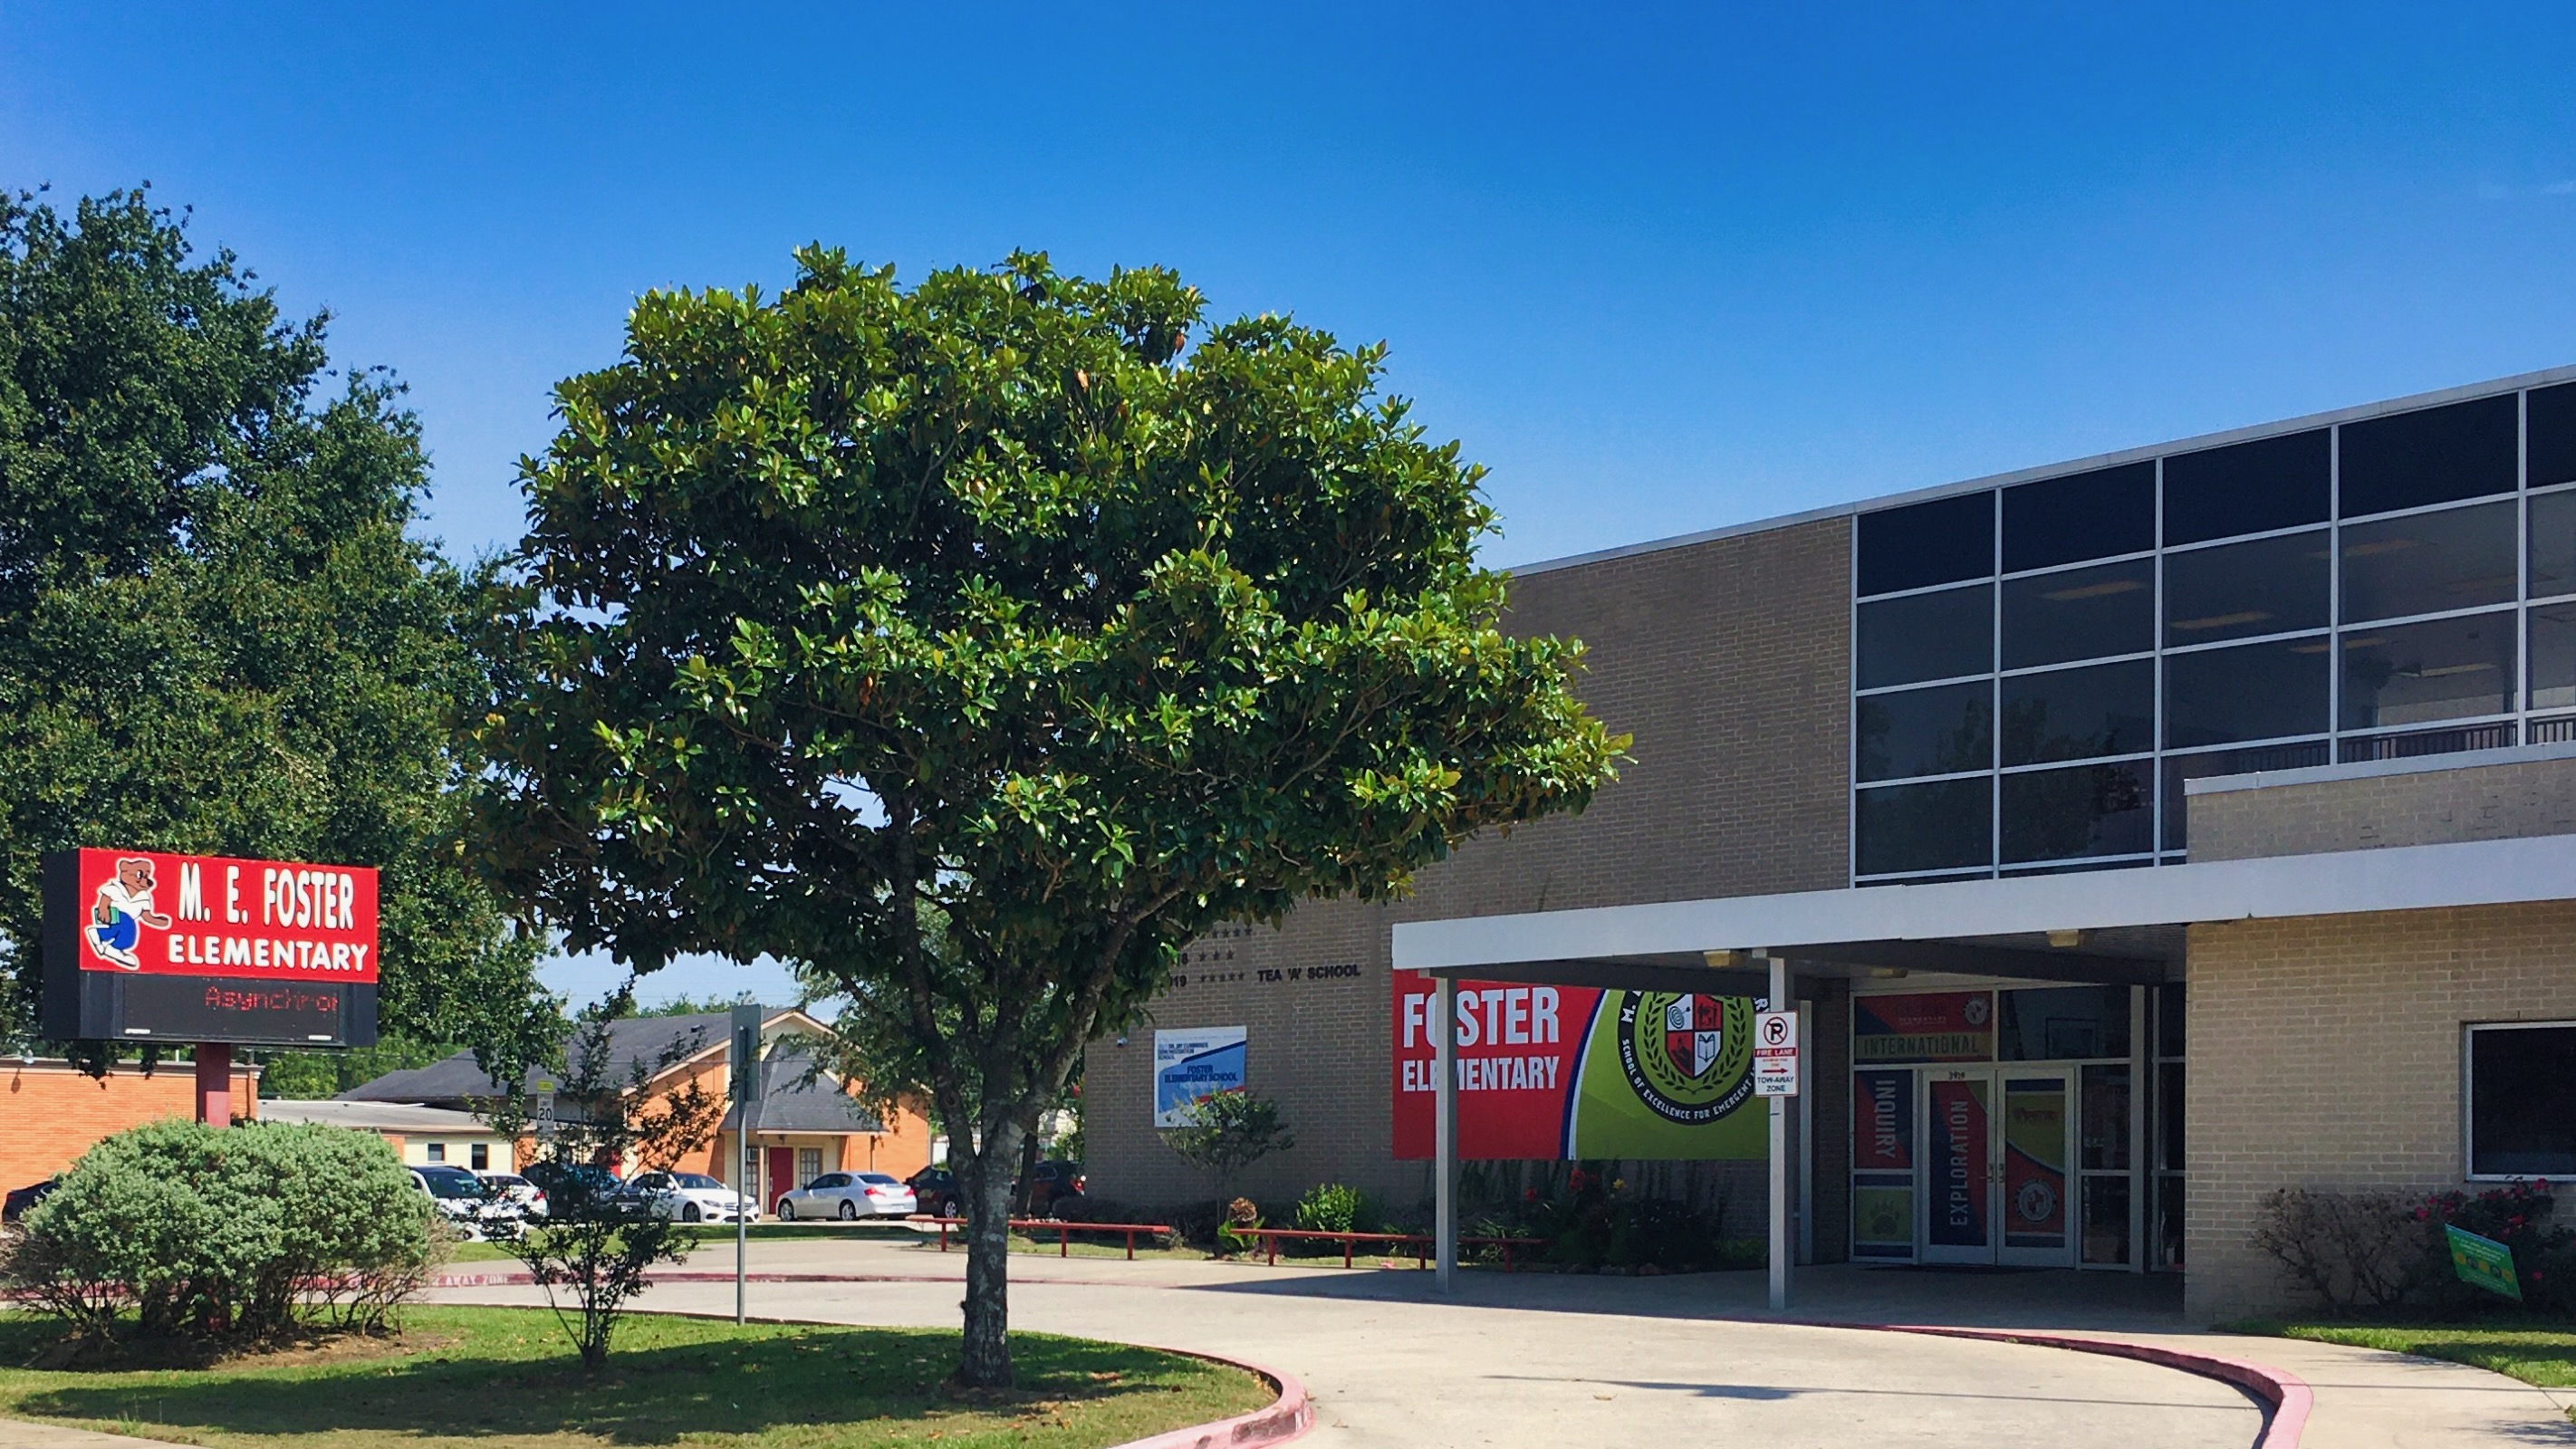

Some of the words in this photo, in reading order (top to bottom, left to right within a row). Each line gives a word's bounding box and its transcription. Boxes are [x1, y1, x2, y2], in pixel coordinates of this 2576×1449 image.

[178, 861, 211, 922] M.
[226, 865, 249, 925] E.
[263, 868, 354, 930] FOSTER
[168, 934, 369, 972] ELEMENTARY
[1257, 969, 1283, 982] TEA
[1307, 964, 1361, 979] SCHOOL
[1756, 1049, 1773, 1057] FIRE
[1774, 1048, 1794, 1056] LANE
[1863, 1035, 1980, 1056] INTERNATIONAL
[1621, 1038, 1638, 1076] SCHOOL
[1633, 1076, 1646, 1090] OF
[1642, 1089, 1691, 1120] EXCELLENCE
[1694, 1108, 1710, 1120] FOR
[1712, 1079, 1753, 1116] EMERGENT
[1757, 1076, 1794, 1084] TOW-AWAY
[539, 1108, 553, 1121] 20
[1875, 1080, 1896, 1159] INQUIRY
[1949, 1100, 1968, 1226] EXPLORATION
